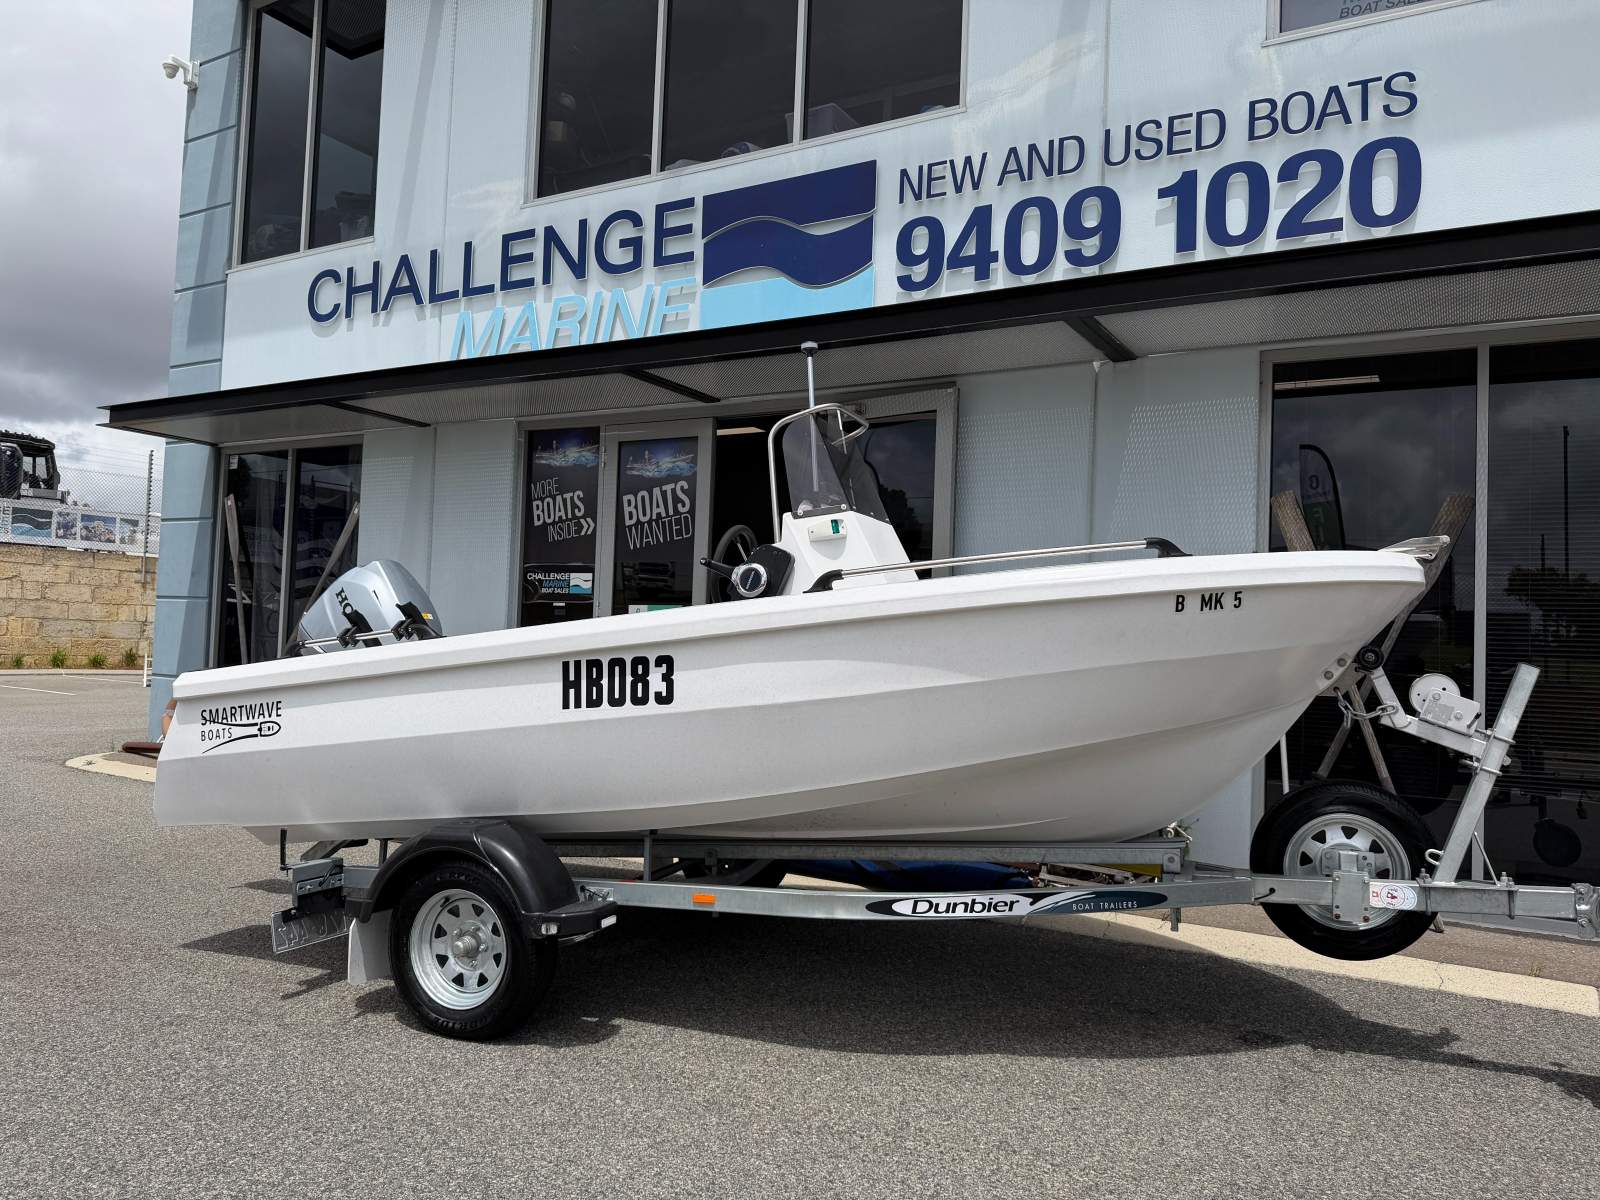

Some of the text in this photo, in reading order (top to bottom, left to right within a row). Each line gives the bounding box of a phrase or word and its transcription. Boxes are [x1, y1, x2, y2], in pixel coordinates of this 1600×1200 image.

[1340, 0, 1383, 18] BOAT
[898, 71, 1419, 204] NEW AND USED BOATS
[895, 136, 1423, 293] 9409 1020
[306, 196, 697, 324] CHALLENGE
[450, 277, 697, 361] MARINE
[531, 477, 560, 500] MORE
[532, 490, 585, 527] BOATS
[622, 480, 691, 527] BOATS
[547, 519, 580, 542] INSIDE
[625, 513, 693, 551] WANTED
[527, 572, 570, 580] CHALLENGE
[1175, 591, 1243, 612] B MK 5
[561, 654, 675, 710] HB083
[200, 700, 282, 726] SMARTWAVE
[200, 727, 233, 741] BOATS
[911, 897, 1019, 914] Dunbier
[1072, 900, 1138, 911] BOAT TRAILERS
